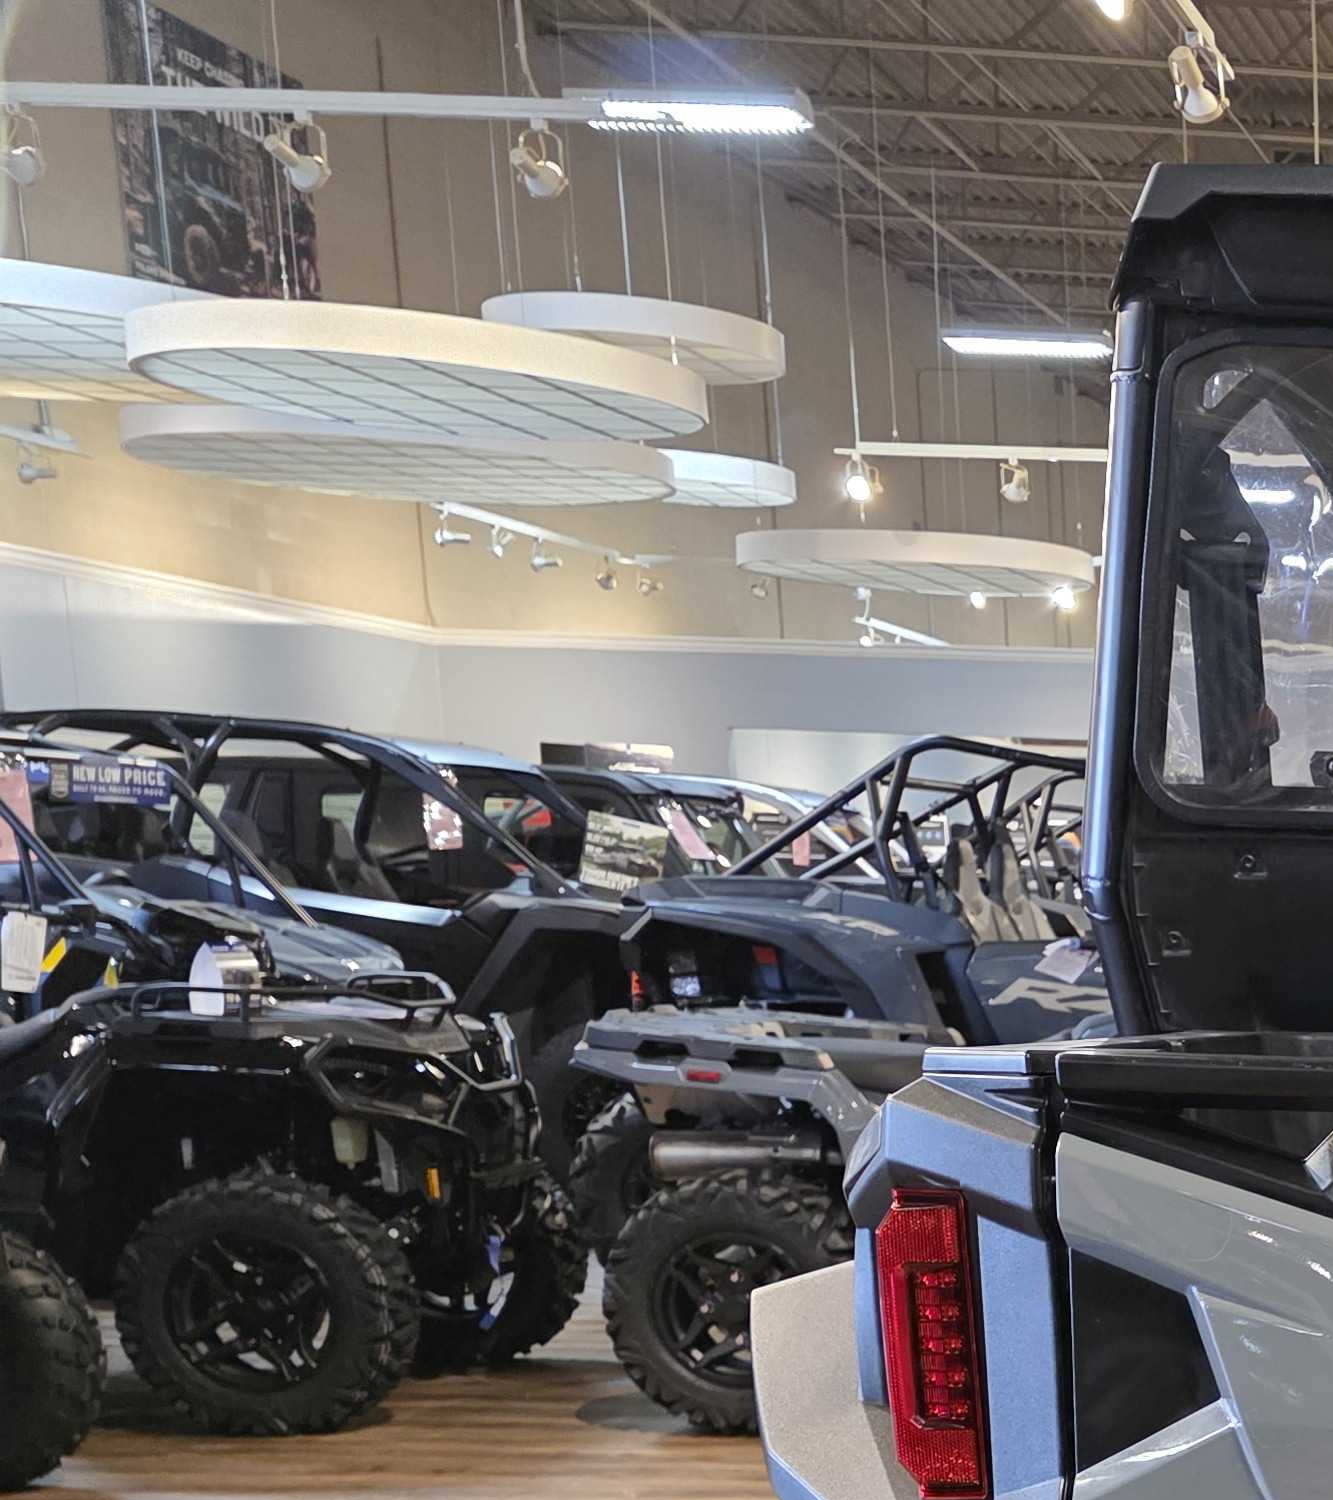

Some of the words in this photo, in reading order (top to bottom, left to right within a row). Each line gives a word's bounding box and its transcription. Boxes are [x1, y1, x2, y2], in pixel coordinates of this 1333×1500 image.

[72, 764, 96, 782] NEW
[98, 766, 121, 784] LOW
[124, 768, 166, 787] PRICE
